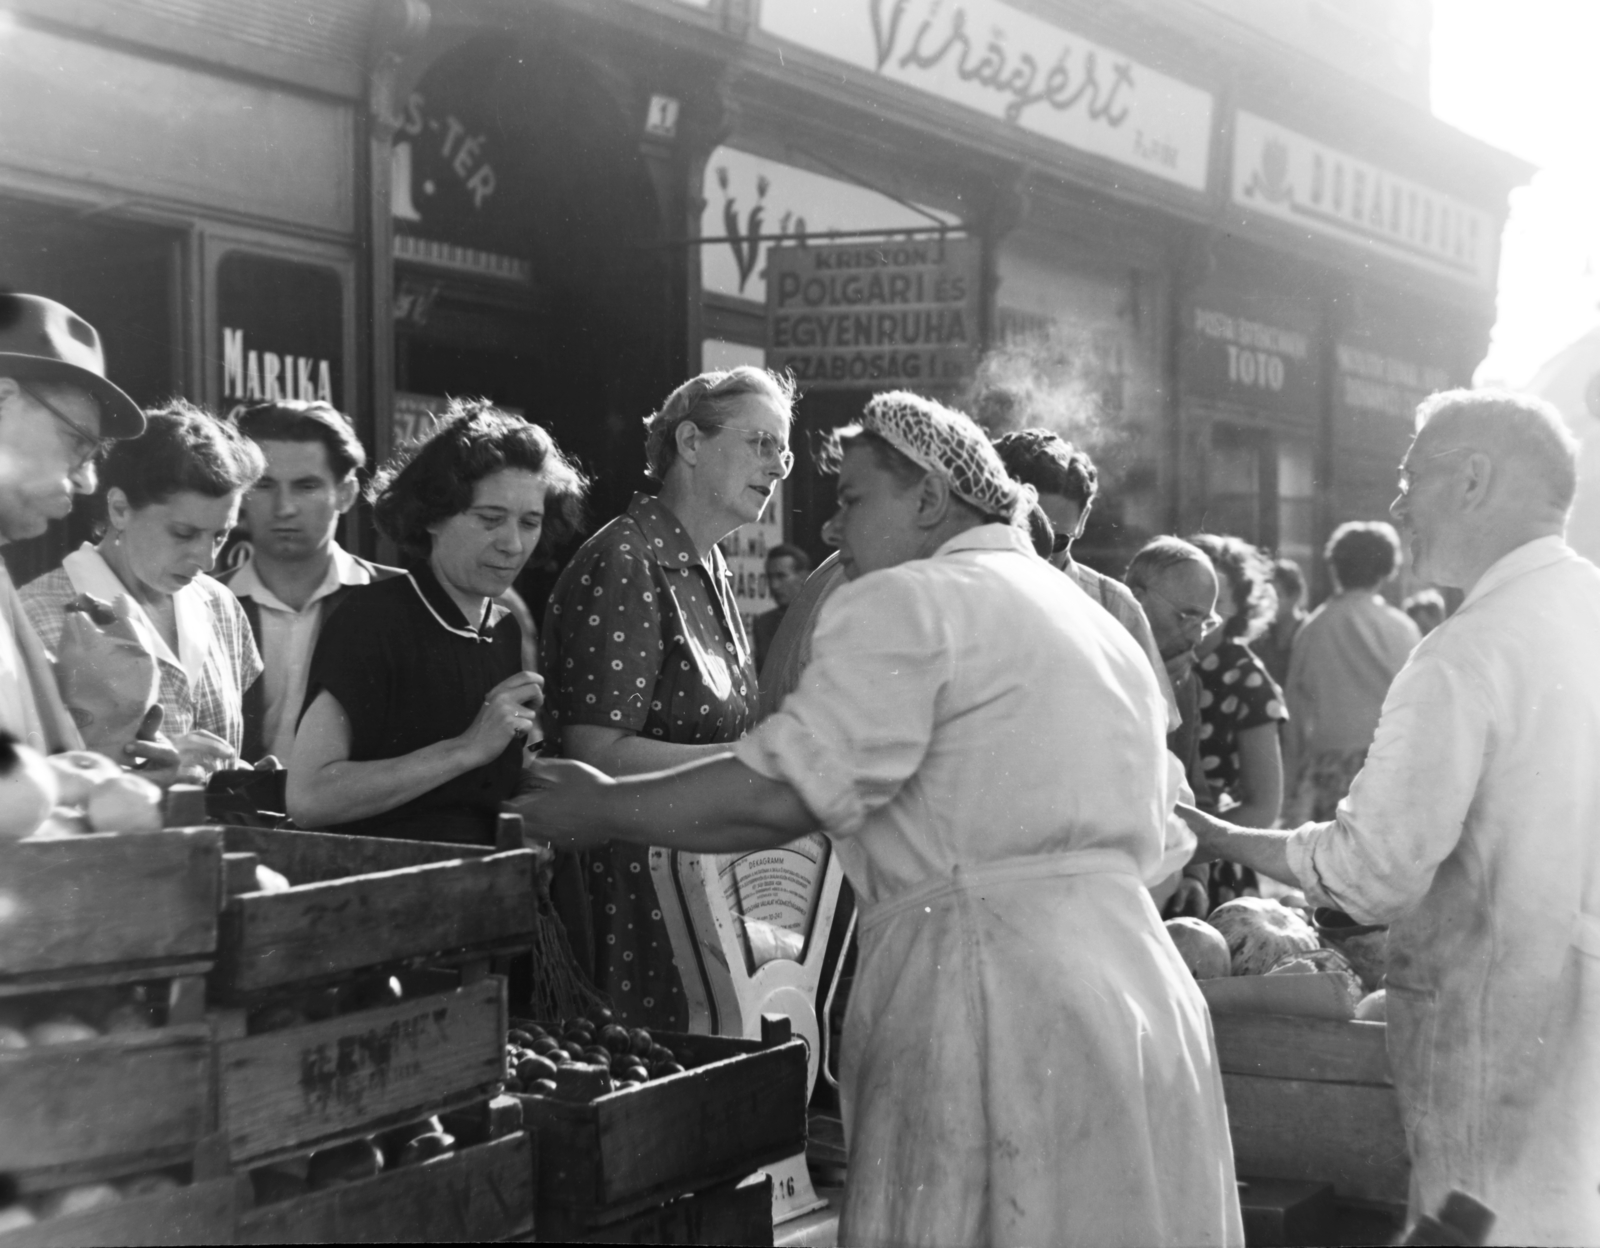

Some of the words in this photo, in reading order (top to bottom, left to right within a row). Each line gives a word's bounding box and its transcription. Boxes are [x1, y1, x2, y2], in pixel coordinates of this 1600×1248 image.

[773, 310, 967, 348] EGYENRUHA
[1226, 345, 1284, 392] TOTO
[748, 857, 785, 870] DEKAGRAMM
